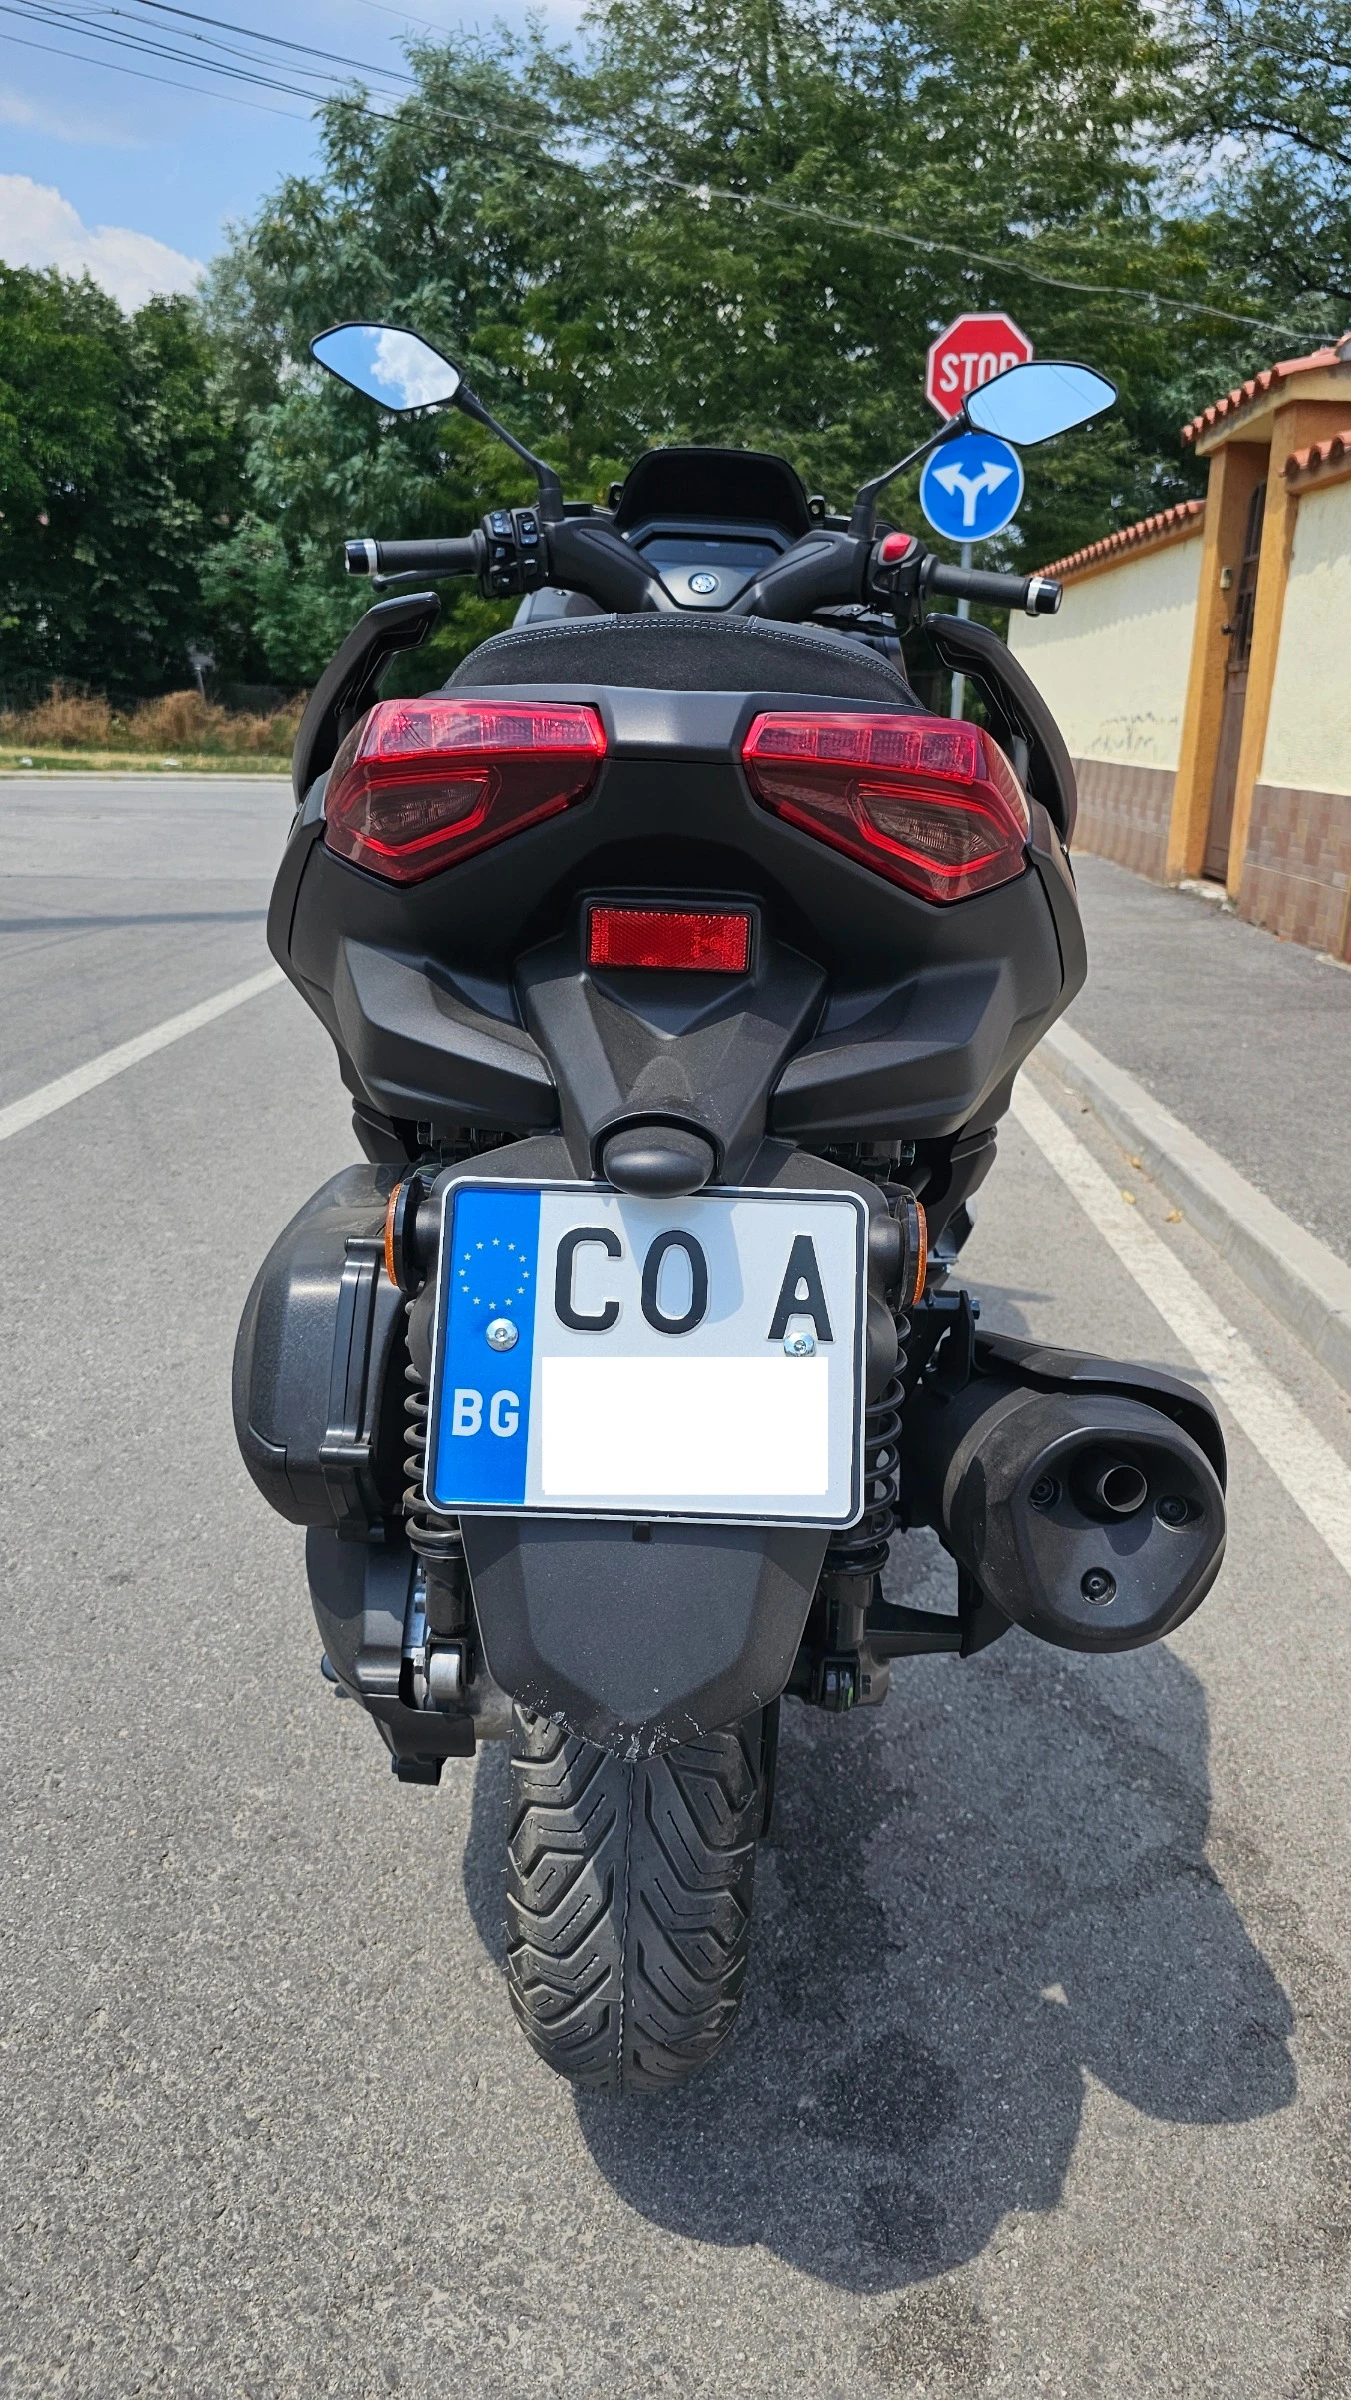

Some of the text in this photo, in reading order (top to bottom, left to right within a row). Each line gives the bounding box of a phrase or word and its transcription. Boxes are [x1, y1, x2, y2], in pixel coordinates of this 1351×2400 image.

[554, 1226, 834, 1342] CO A
[452, 1388, 520, 1438] BG
